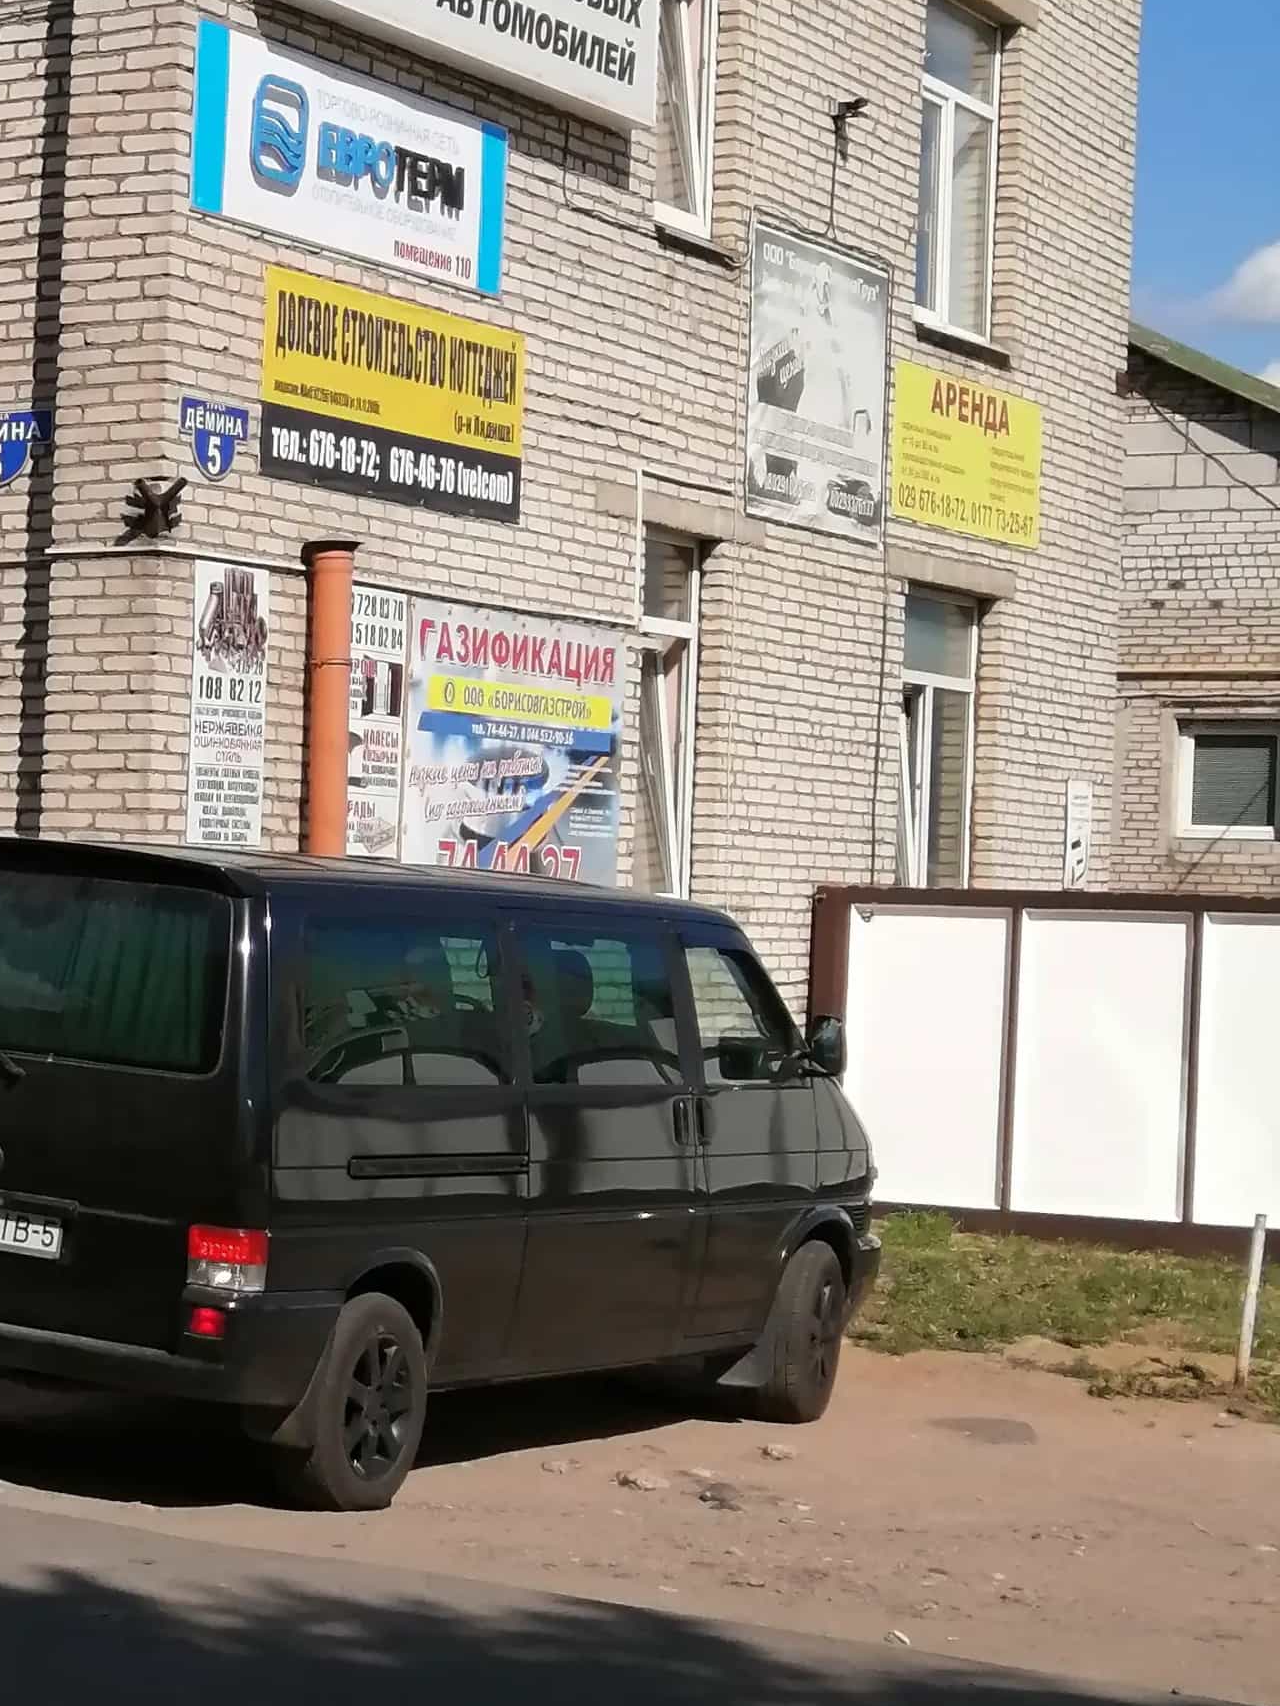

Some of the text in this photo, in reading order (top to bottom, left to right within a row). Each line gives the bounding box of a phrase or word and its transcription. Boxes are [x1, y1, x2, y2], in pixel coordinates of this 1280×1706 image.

[318, 121, 466, 213] ЕВРОТЕРМ
[393, 239, 472, 280] помещение 110
[274, 289, 339, 362] ДОЛЕВОЕ
[341, 306, 446, 390] СТРОИТЕЛЬСТВО
[448, 336, 518, 411] КОТТЕДЖЕЙ
[184, 407, 244, 439] ДЁМИНА
[931, 377, 1011, 440] АРЕНДА
[206, 436, 222, 476] 5
[272, 426, 513, 505] тел.: 676-18-72; 676-46-76 (velcom)
[898, 482, 916, 509] 029
[419, 617, 617, 689] ГАЗИФИКАЦИЯ
[199, 675, 223, 701] 108
[248, 680, 262, 704] 12
[463, 684, 485, 707] ООО
